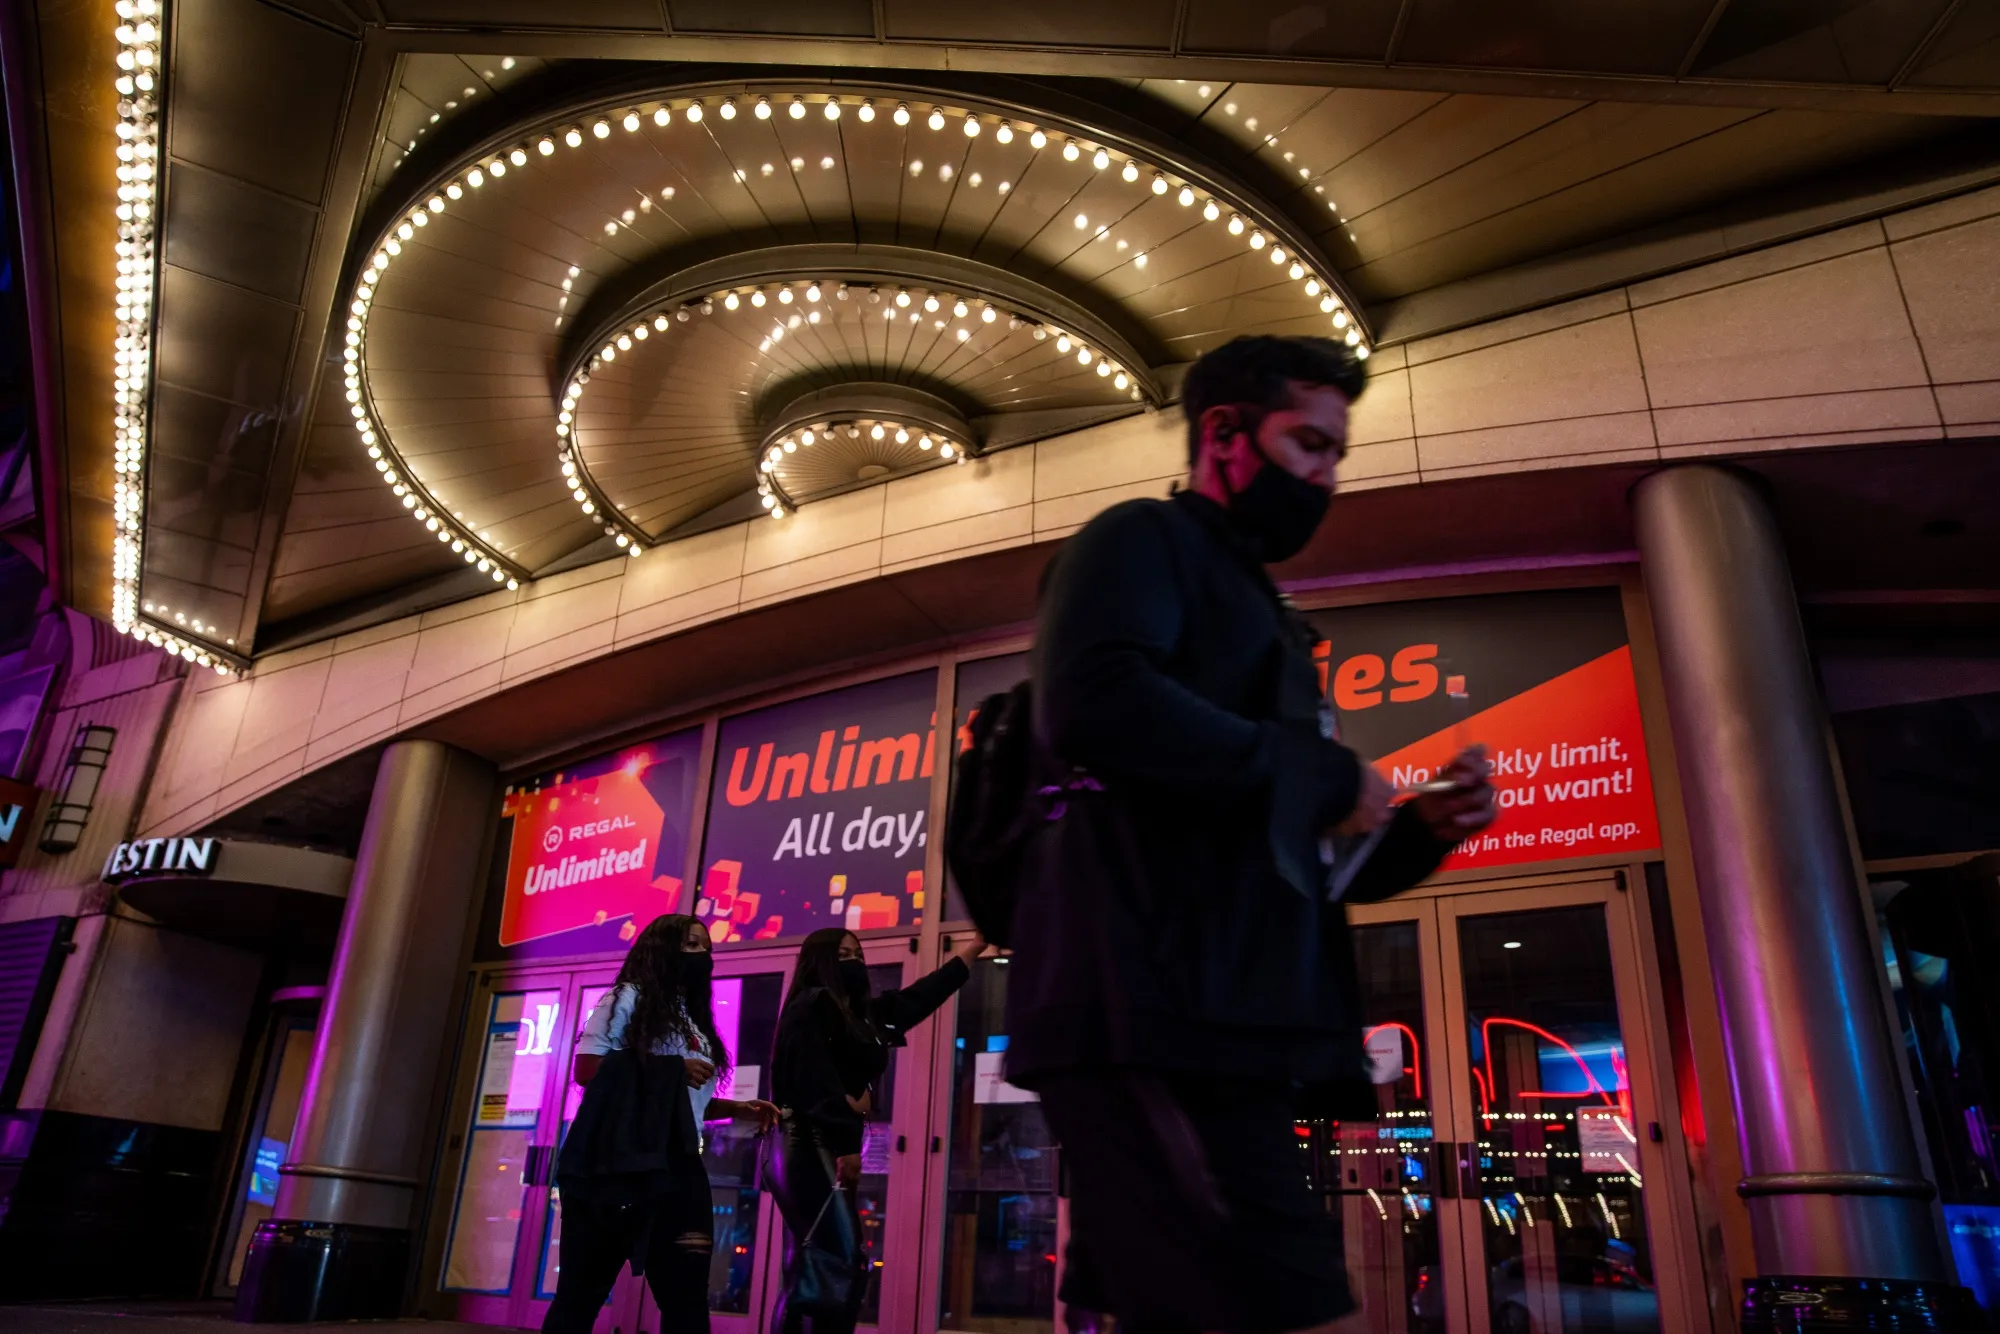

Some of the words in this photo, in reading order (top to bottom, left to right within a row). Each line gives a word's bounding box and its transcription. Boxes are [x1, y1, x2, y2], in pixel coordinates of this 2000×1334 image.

[1392, 764, 1429, 789] No
[1550, 736, 1628, 769] limit,
[1544, 767, 1633, 803] want!
[568, 815, 636, 841] REGAL
[773, 811, 834, 861] All
[841, 805, 927, 859] day,
[1482, 832, 1500, 852] in
[1505, 829, 1536, 849] the
[1540, 822, 1594, 847] Regal
[1599, 821, 1641, 844] app.
[523, 838, 647, 896] Unlimited
